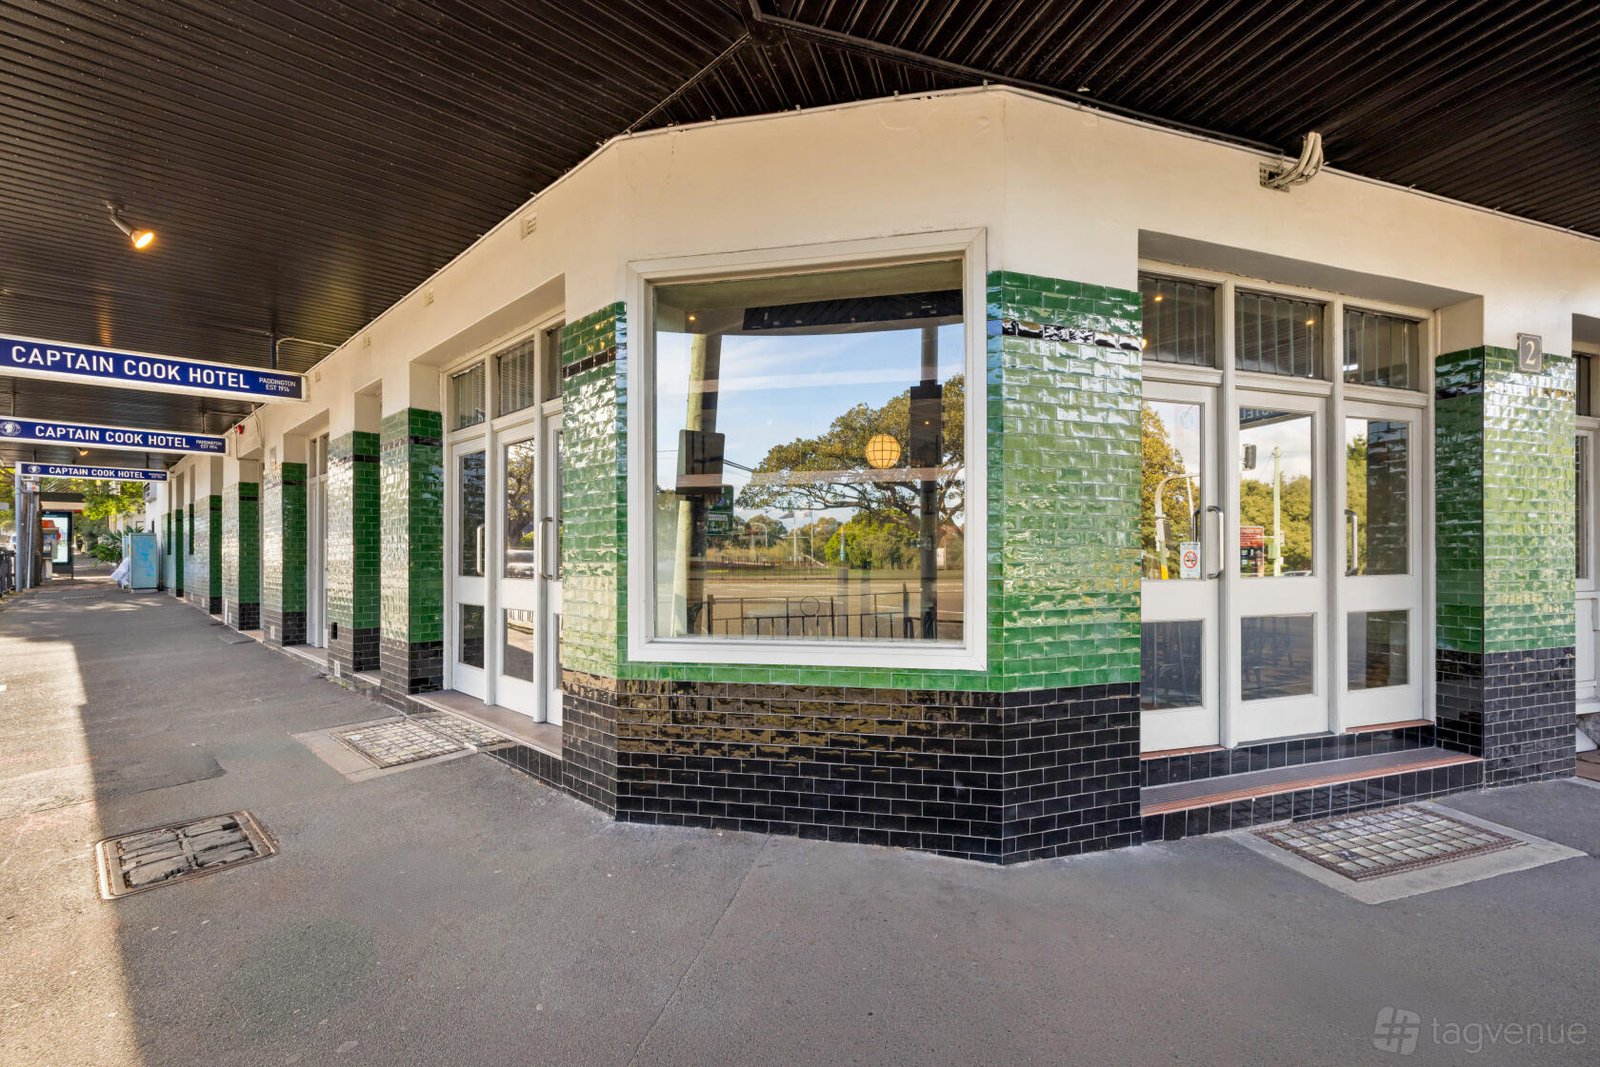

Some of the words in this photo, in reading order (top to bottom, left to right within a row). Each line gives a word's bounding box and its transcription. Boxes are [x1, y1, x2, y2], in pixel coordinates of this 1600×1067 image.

[1525, 340, 1536, 365] 2
[11, 345, 114, 373] CAPTAIN
[123, 359, 181, 381] COOK
[188, 367, 250, 388] HOTEL
[258, 377, 296, 387] PADDINGTON
[35, 425, 100, 441] CAPTAIN
[105, 431, 144, 445] COOK
[148, 435, 190, 448] HOTEL
[49, 466, 89, 476] CAPTAIN
[91, 468, 115, 477] COOK
[117, 470, 145, 479] HOTEL
